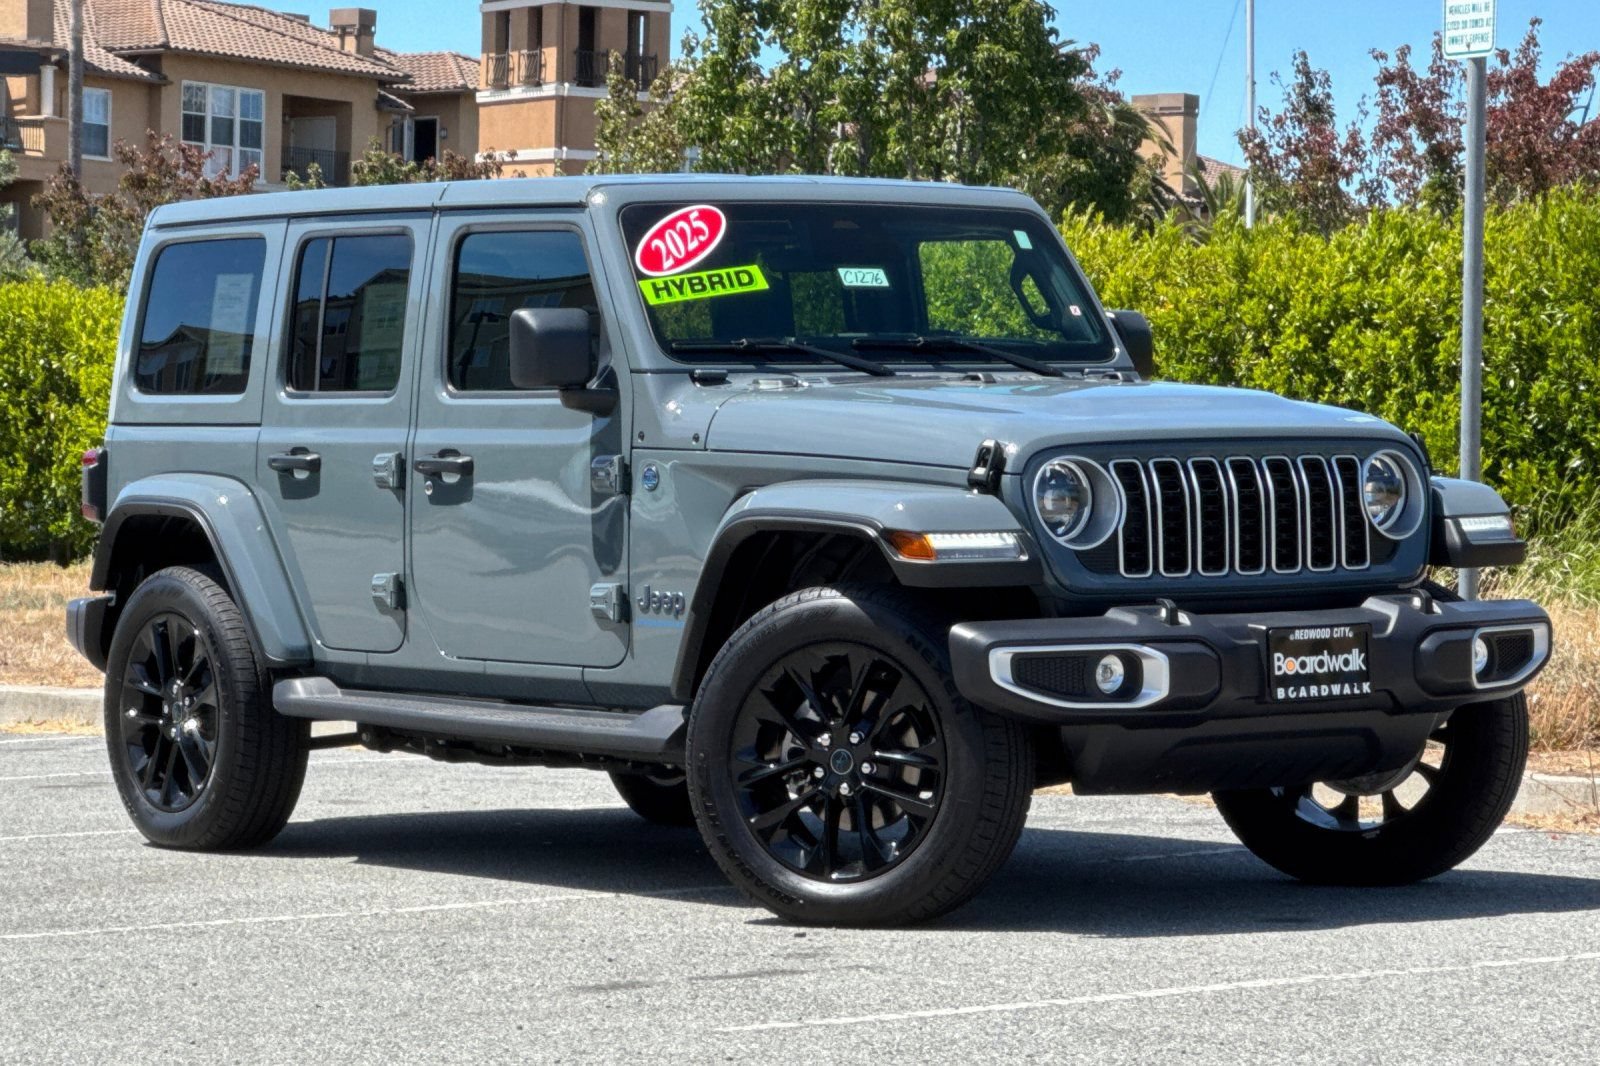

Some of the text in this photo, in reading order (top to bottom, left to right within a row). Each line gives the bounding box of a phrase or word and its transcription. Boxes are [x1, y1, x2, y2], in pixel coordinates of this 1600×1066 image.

[651, 210, 709, 270] 2025
[650, 269, 755, 299] HYBRID
[843, 270, 883, 285] C1276
[637, 584, 686, 620] Jeep
[1294, 626, 1350, 640] REDWOOD CITY
[1273, 648, 1367, 675] Boardwalk
[1276, 682, 1371, 700] BOARDWALK
